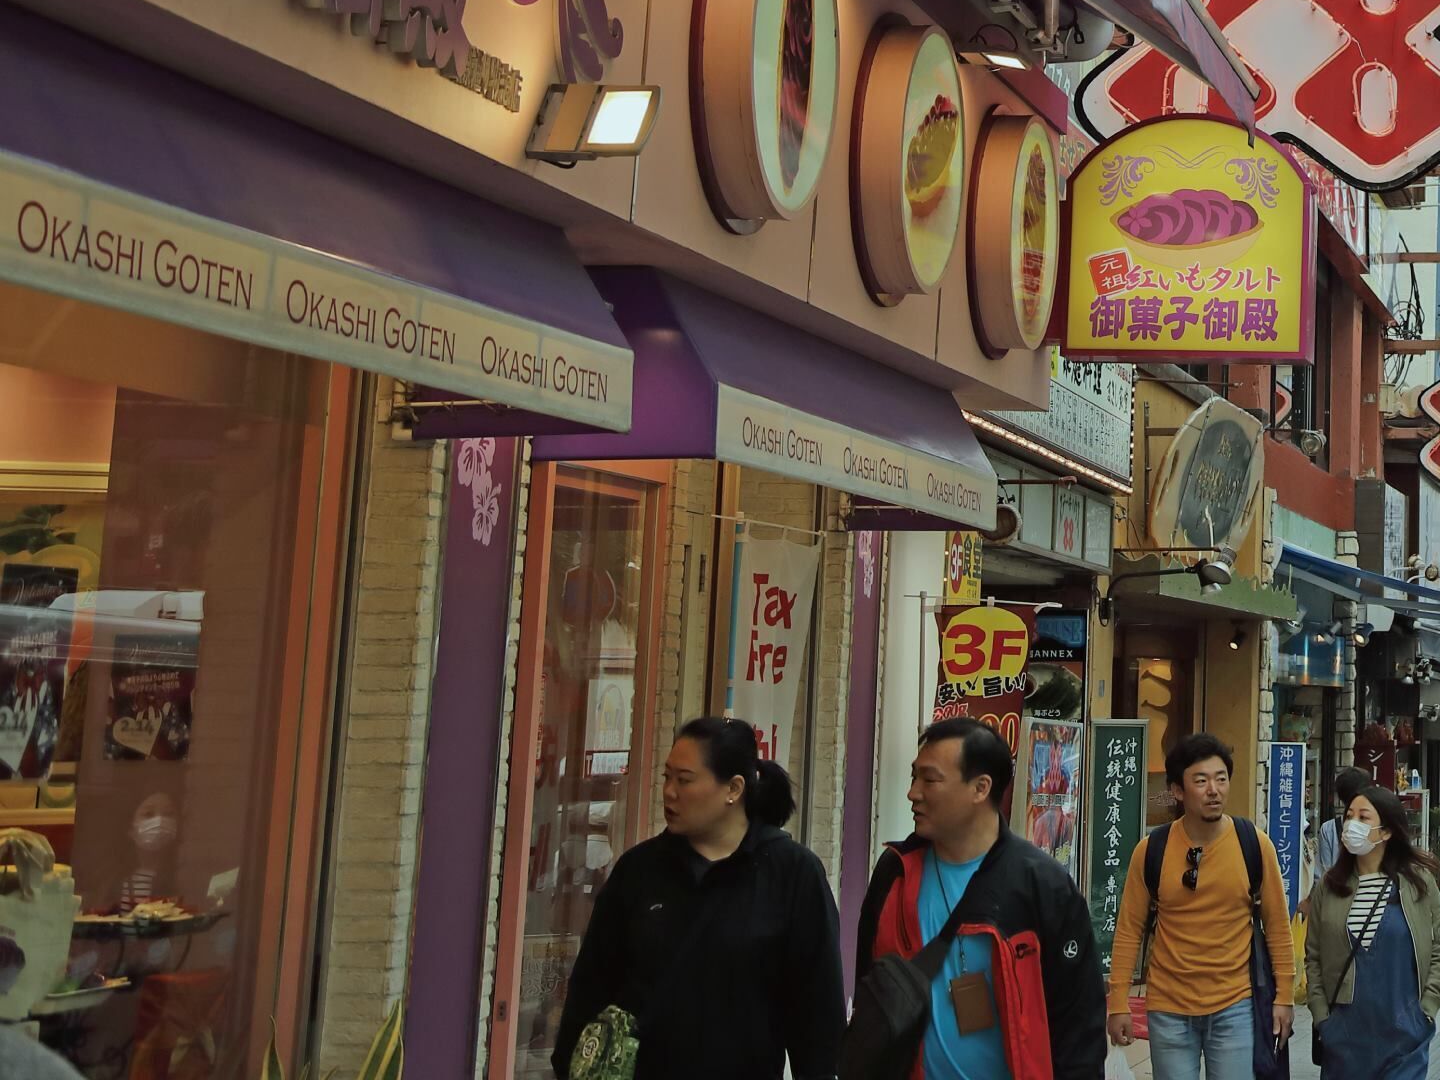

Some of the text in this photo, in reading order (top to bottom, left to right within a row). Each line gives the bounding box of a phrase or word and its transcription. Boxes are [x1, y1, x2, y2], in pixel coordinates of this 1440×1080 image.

[1099, 257, 1127, 290] 元祖
[1126, 262, 1281, 293] 紅いもタルト
[1088, 295, 1279, 342] 御菓子御殿
[752, 573, 798, 629] Tax
[945, 623, 1026, 676] 3F
[1123, 736, 1137, 787] 沖縄の
[1368, 748, 1384, 787] シー
[1103, 737, 1124, 867] 伝統健康食品
